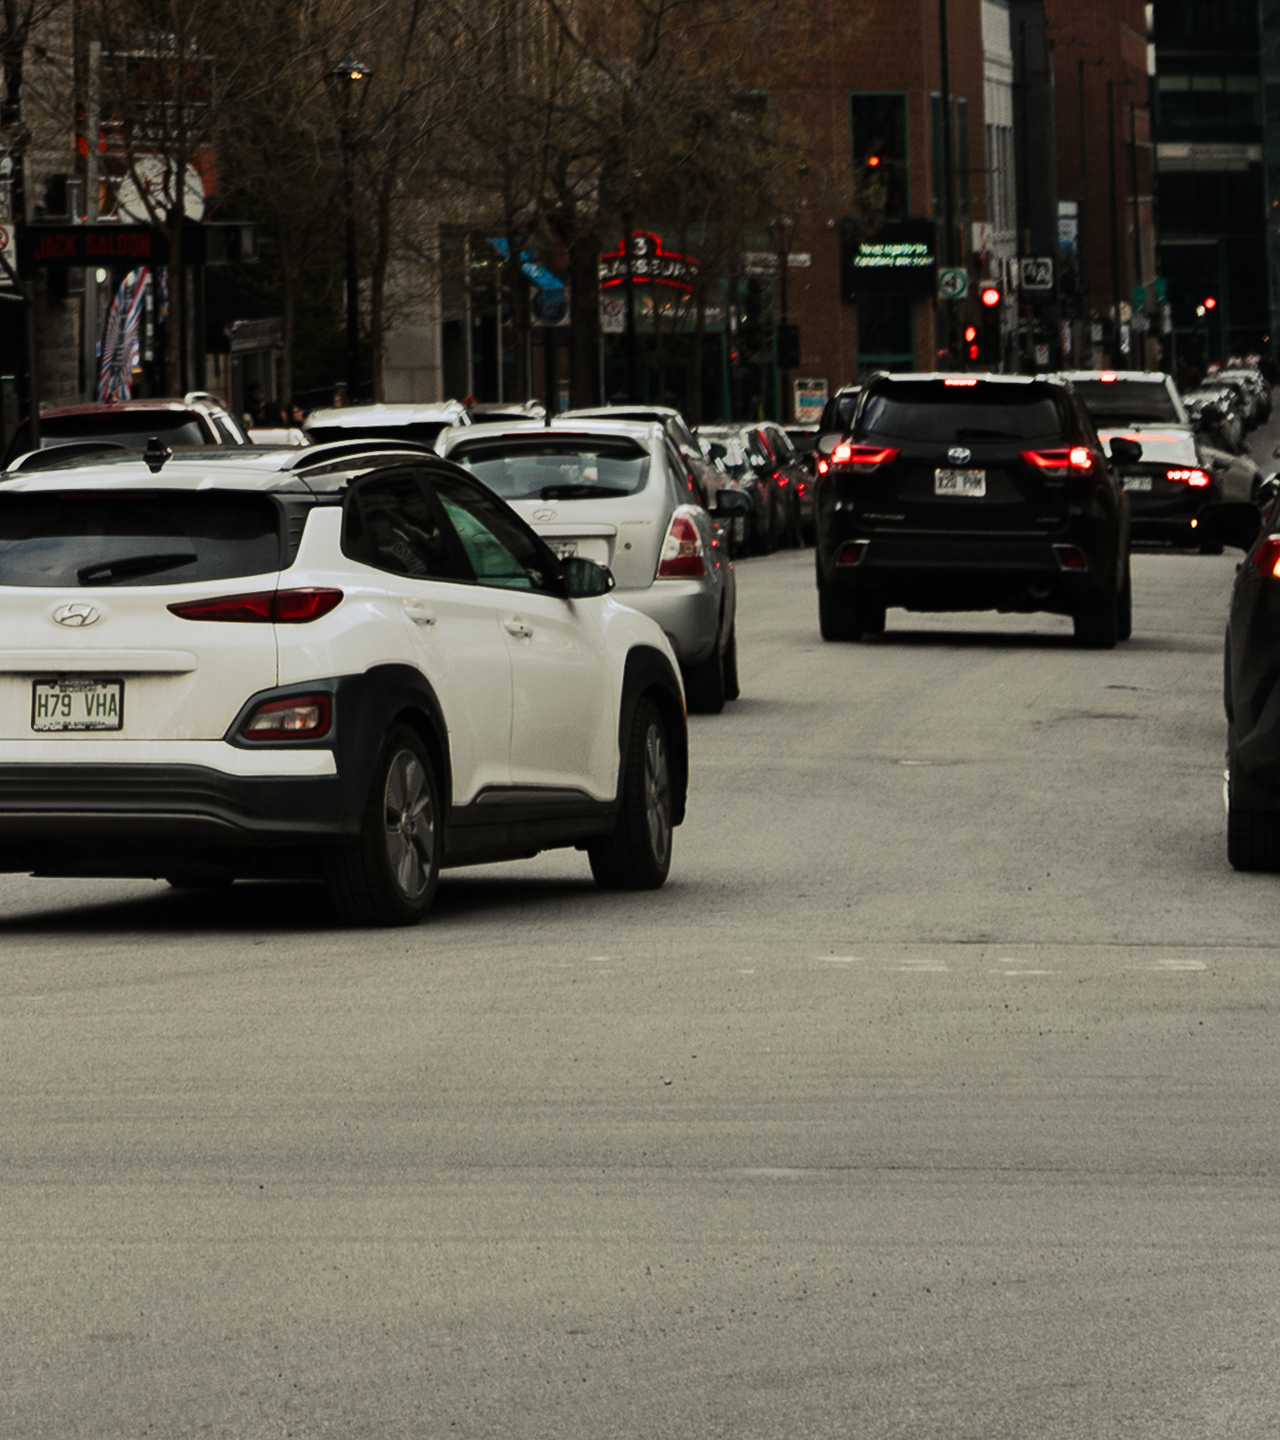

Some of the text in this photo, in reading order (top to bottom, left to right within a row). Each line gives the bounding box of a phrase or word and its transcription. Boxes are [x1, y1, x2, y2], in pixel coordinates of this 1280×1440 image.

[34, 232, 152, 260] JACK SALOON
[38, 693, 118, 717] H79 VHA
